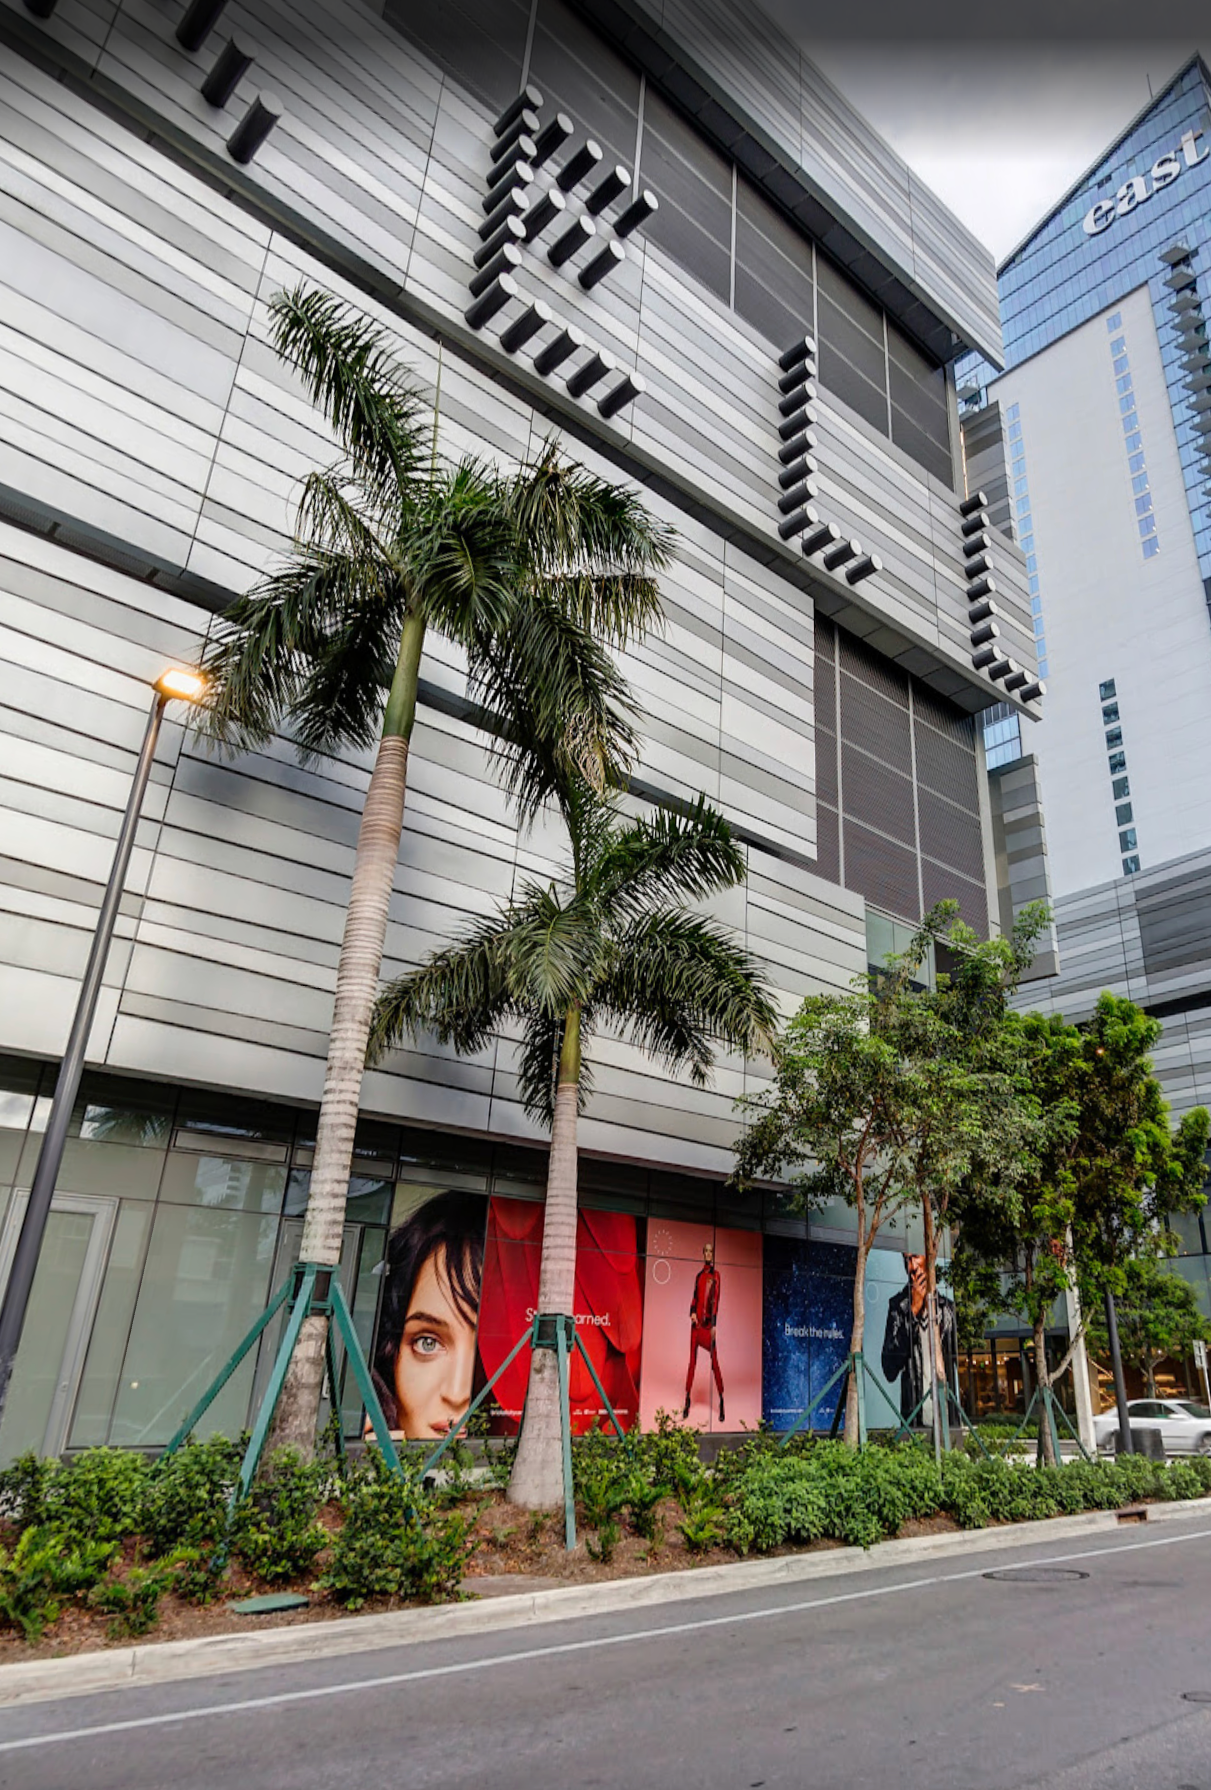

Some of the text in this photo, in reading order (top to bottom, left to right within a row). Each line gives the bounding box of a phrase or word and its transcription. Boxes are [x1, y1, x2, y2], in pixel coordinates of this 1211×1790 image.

[1082, 129, 1211, 236] east
[785, 1322, 809, 1338] Break
[809, 1324, 823, 1338] the
